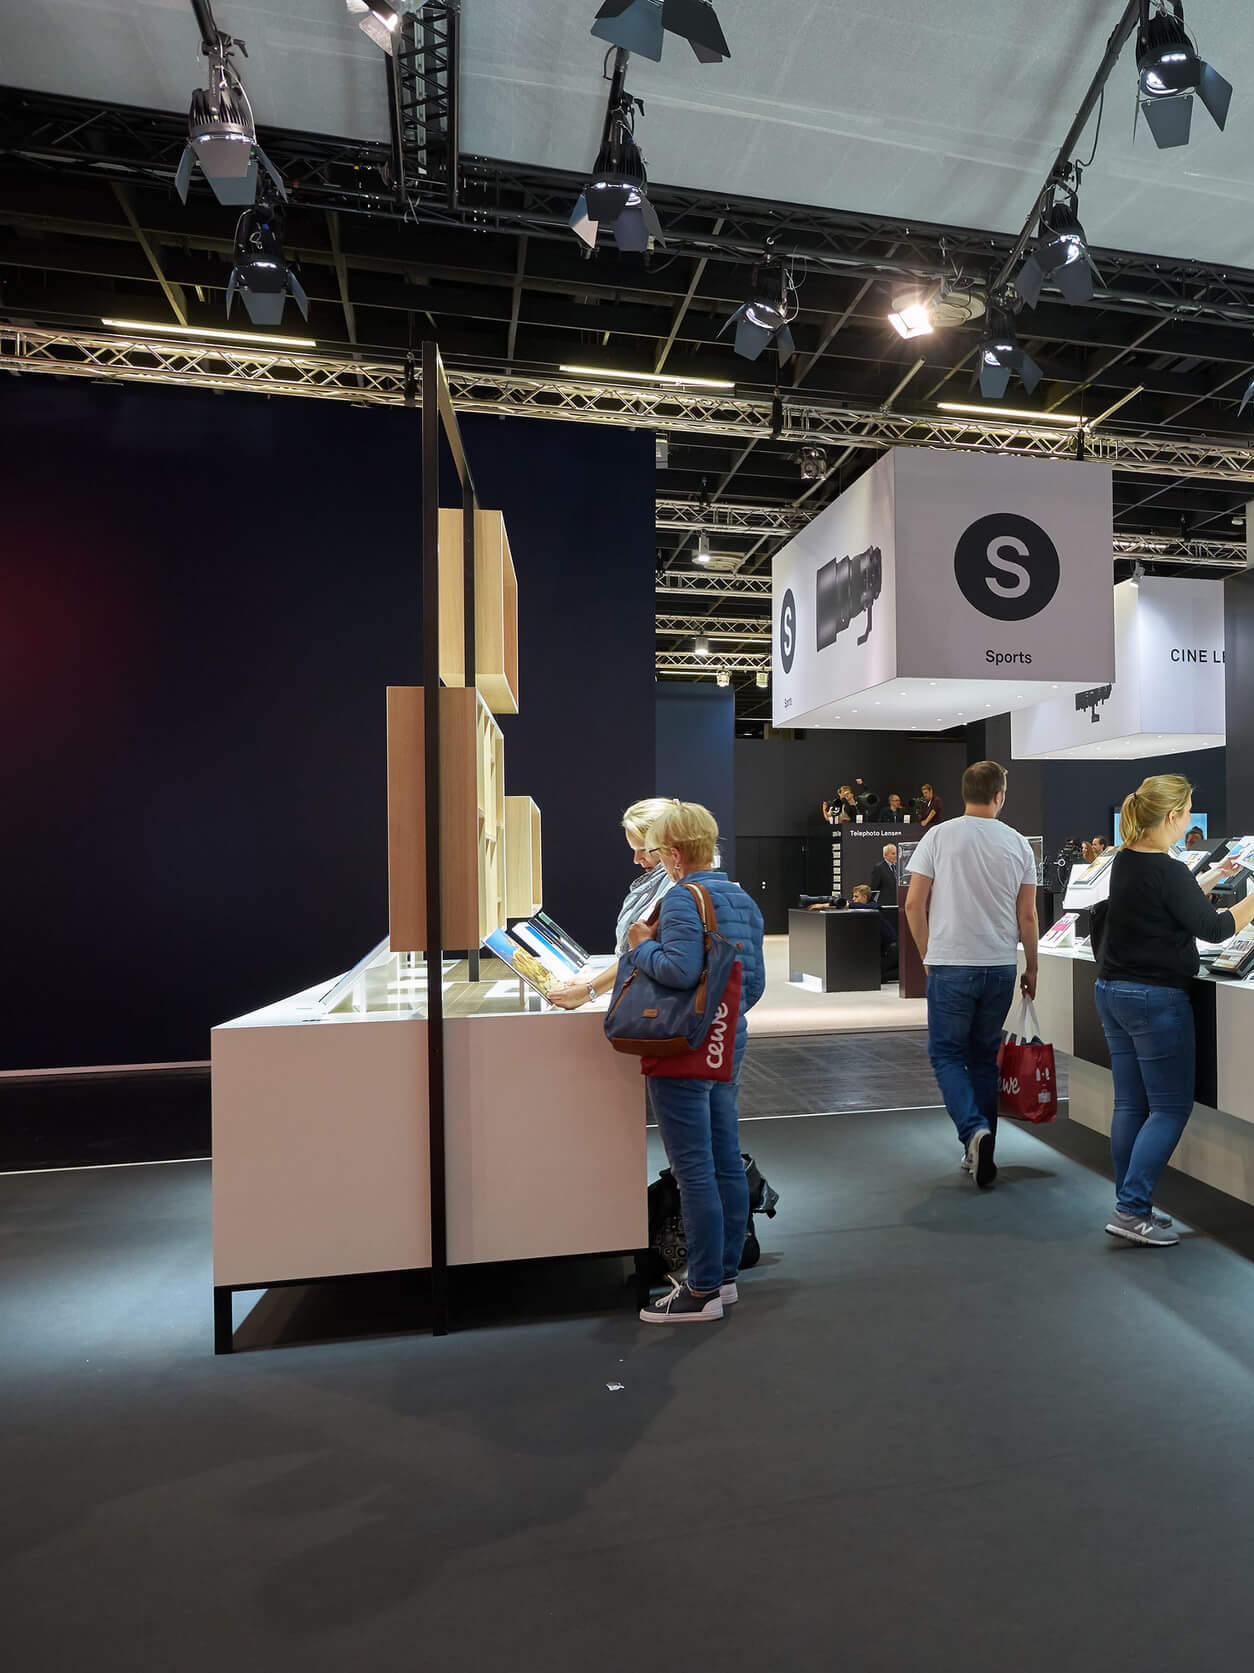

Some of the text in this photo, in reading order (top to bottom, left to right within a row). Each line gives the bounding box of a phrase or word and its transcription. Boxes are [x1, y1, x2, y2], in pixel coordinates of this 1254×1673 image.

[984, 535, 1032, 599] S
[985, 650, 1032, 665] Sports
[1170, 648, 1208, 663] CINE
[706, 1002, 729, 1069] cewe
[999, 1076, 1021, 1095] we
